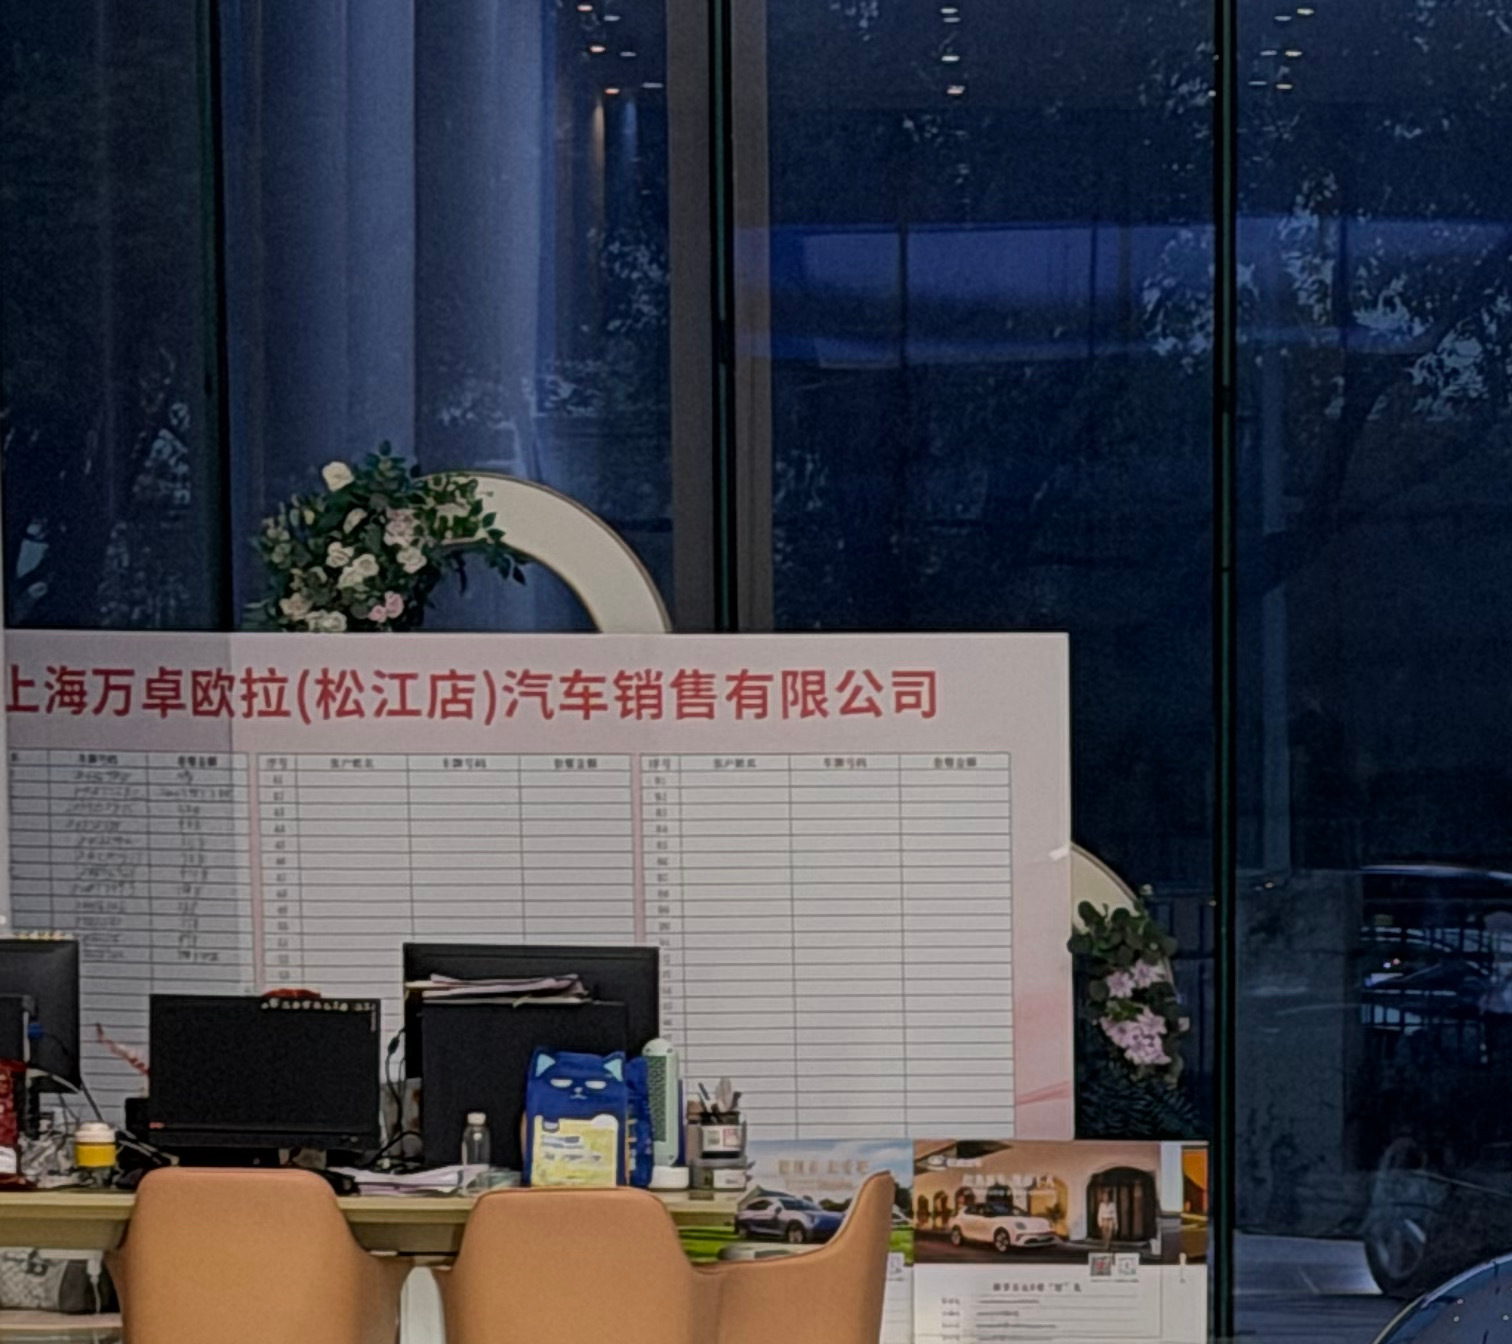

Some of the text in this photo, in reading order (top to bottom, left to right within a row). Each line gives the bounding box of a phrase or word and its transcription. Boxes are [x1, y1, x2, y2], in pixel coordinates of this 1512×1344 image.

[5, 664, 938, 726] 上海万卓欧拉(松江店)汽车销售有限公司
